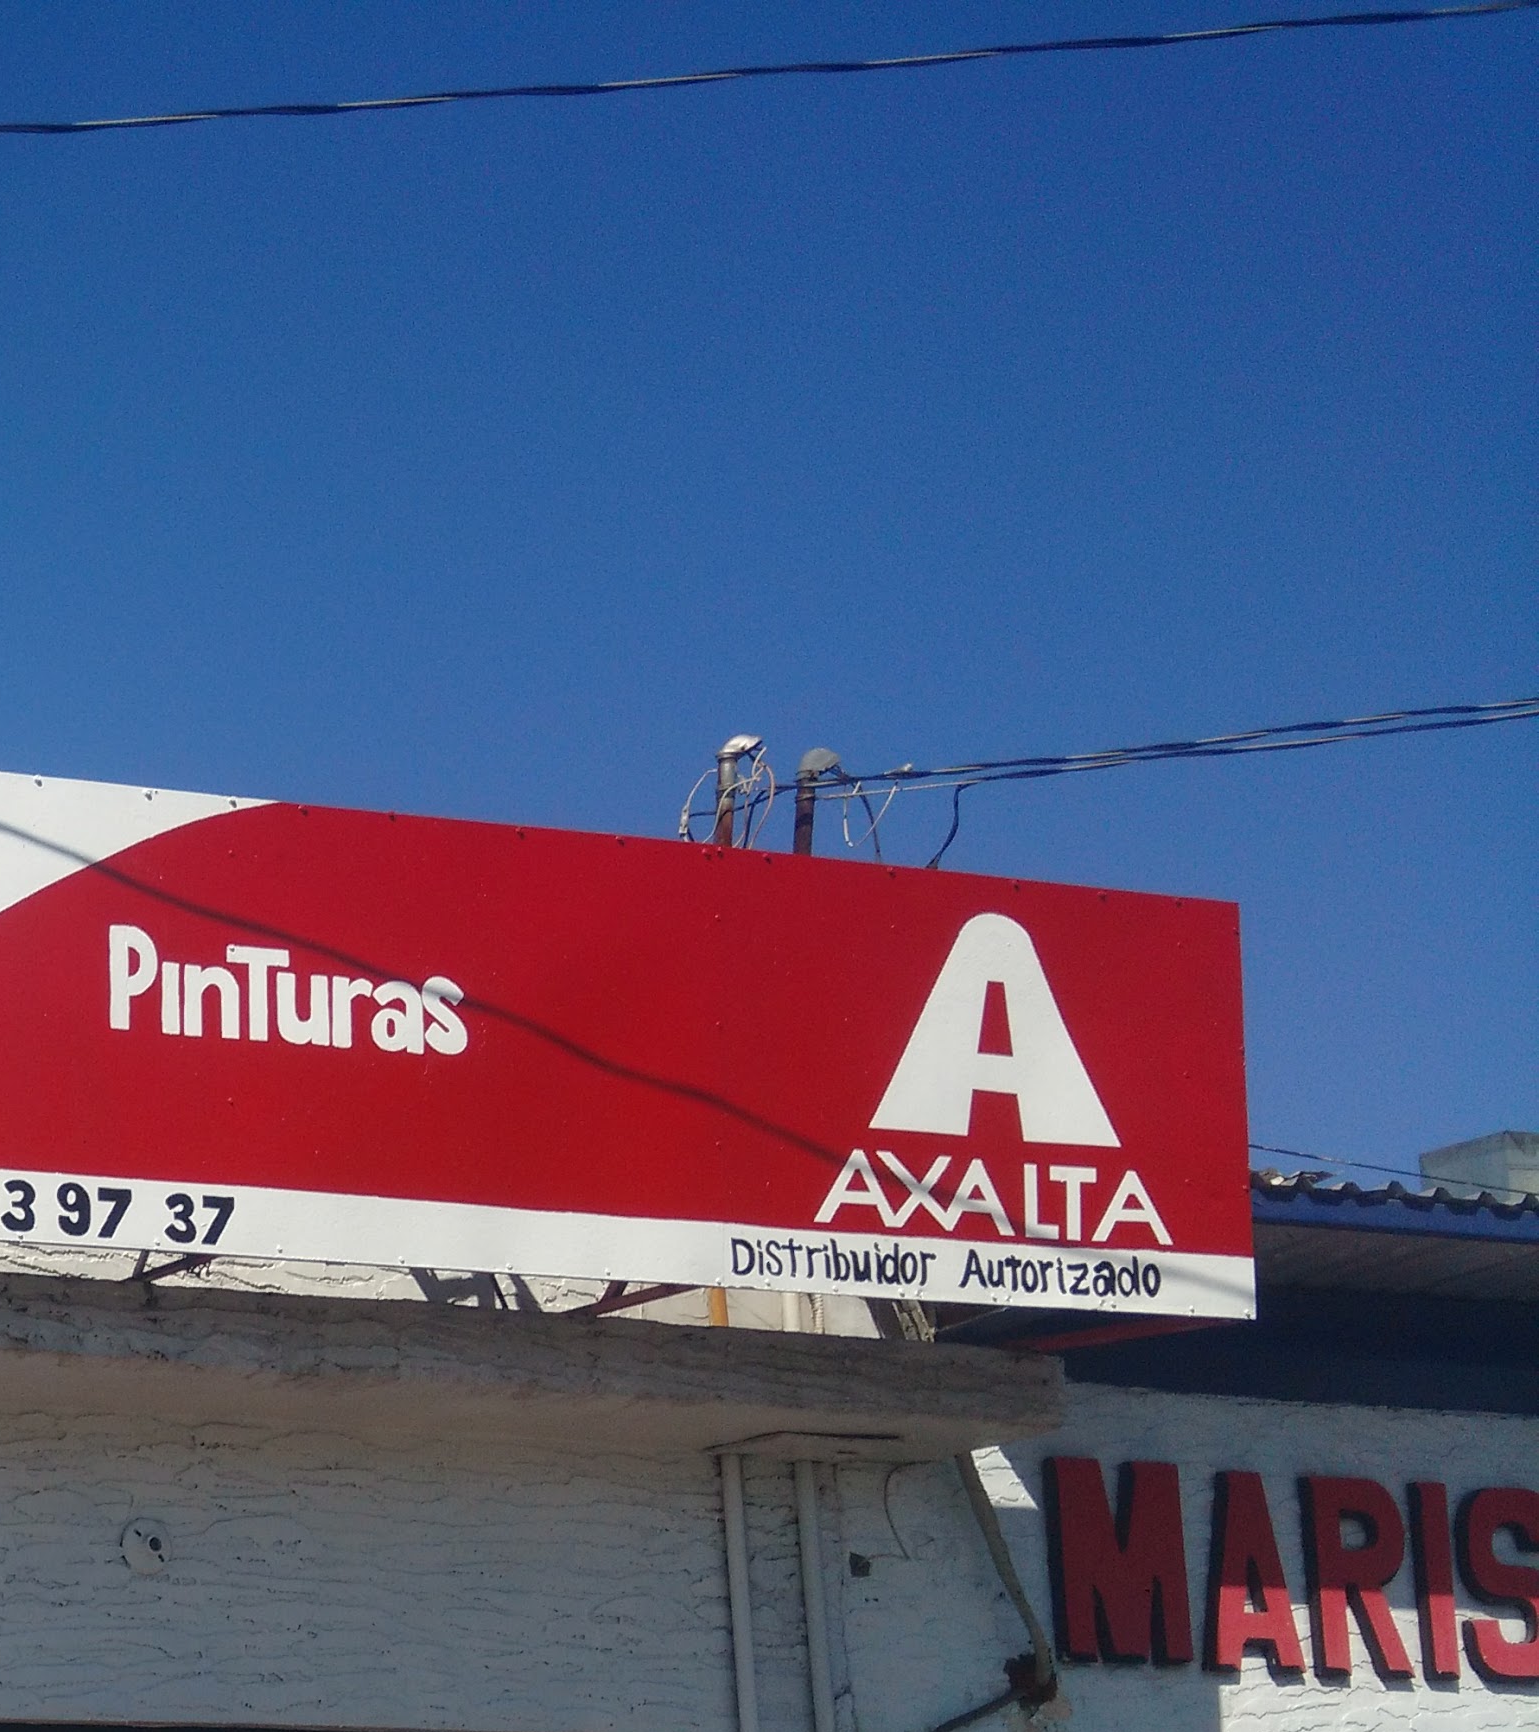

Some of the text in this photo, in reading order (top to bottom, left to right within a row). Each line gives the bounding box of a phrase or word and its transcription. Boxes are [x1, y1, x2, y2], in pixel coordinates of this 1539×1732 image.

[868, 912, 1122, 1148] A
[56, 1181, 132, 1239] 97
[164, 1192, 235, 1246] 37
[813, 1148, 1174, 1246] AXALTA
[730, 1237, 1162, 1298] Distribuidor Autorizado
